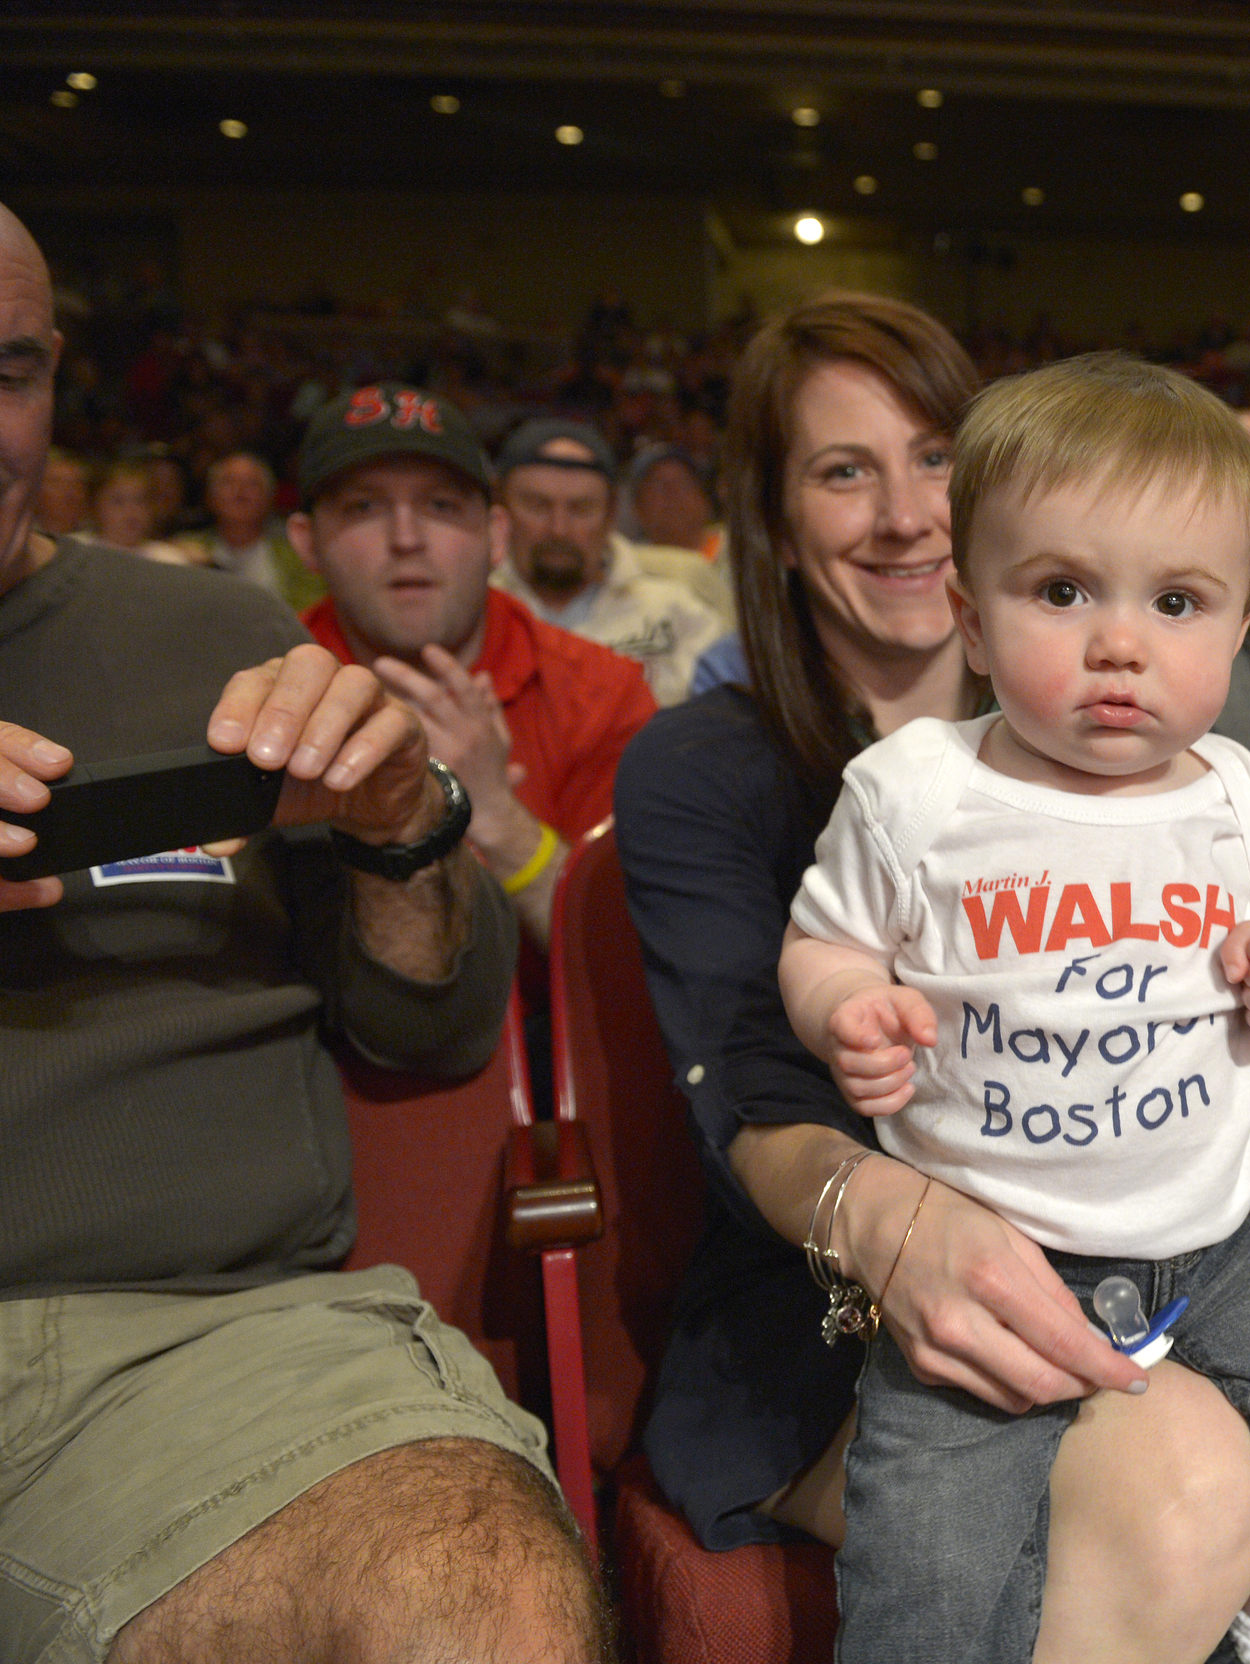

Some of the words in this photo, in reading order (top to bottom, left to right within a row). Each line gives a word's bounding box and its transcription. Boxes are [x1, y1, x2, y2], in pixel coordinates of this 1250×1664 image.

[962, 873, 1030, 897] Martin
[1034, 869, 1052, 886] J.
[961, 882, 1237, 960] WALSH
[1055, 953, 1168, 1003] For
[961, 1001, 1164, 1077] Mayor
[980, 1073, 1211, 1147] Boston
